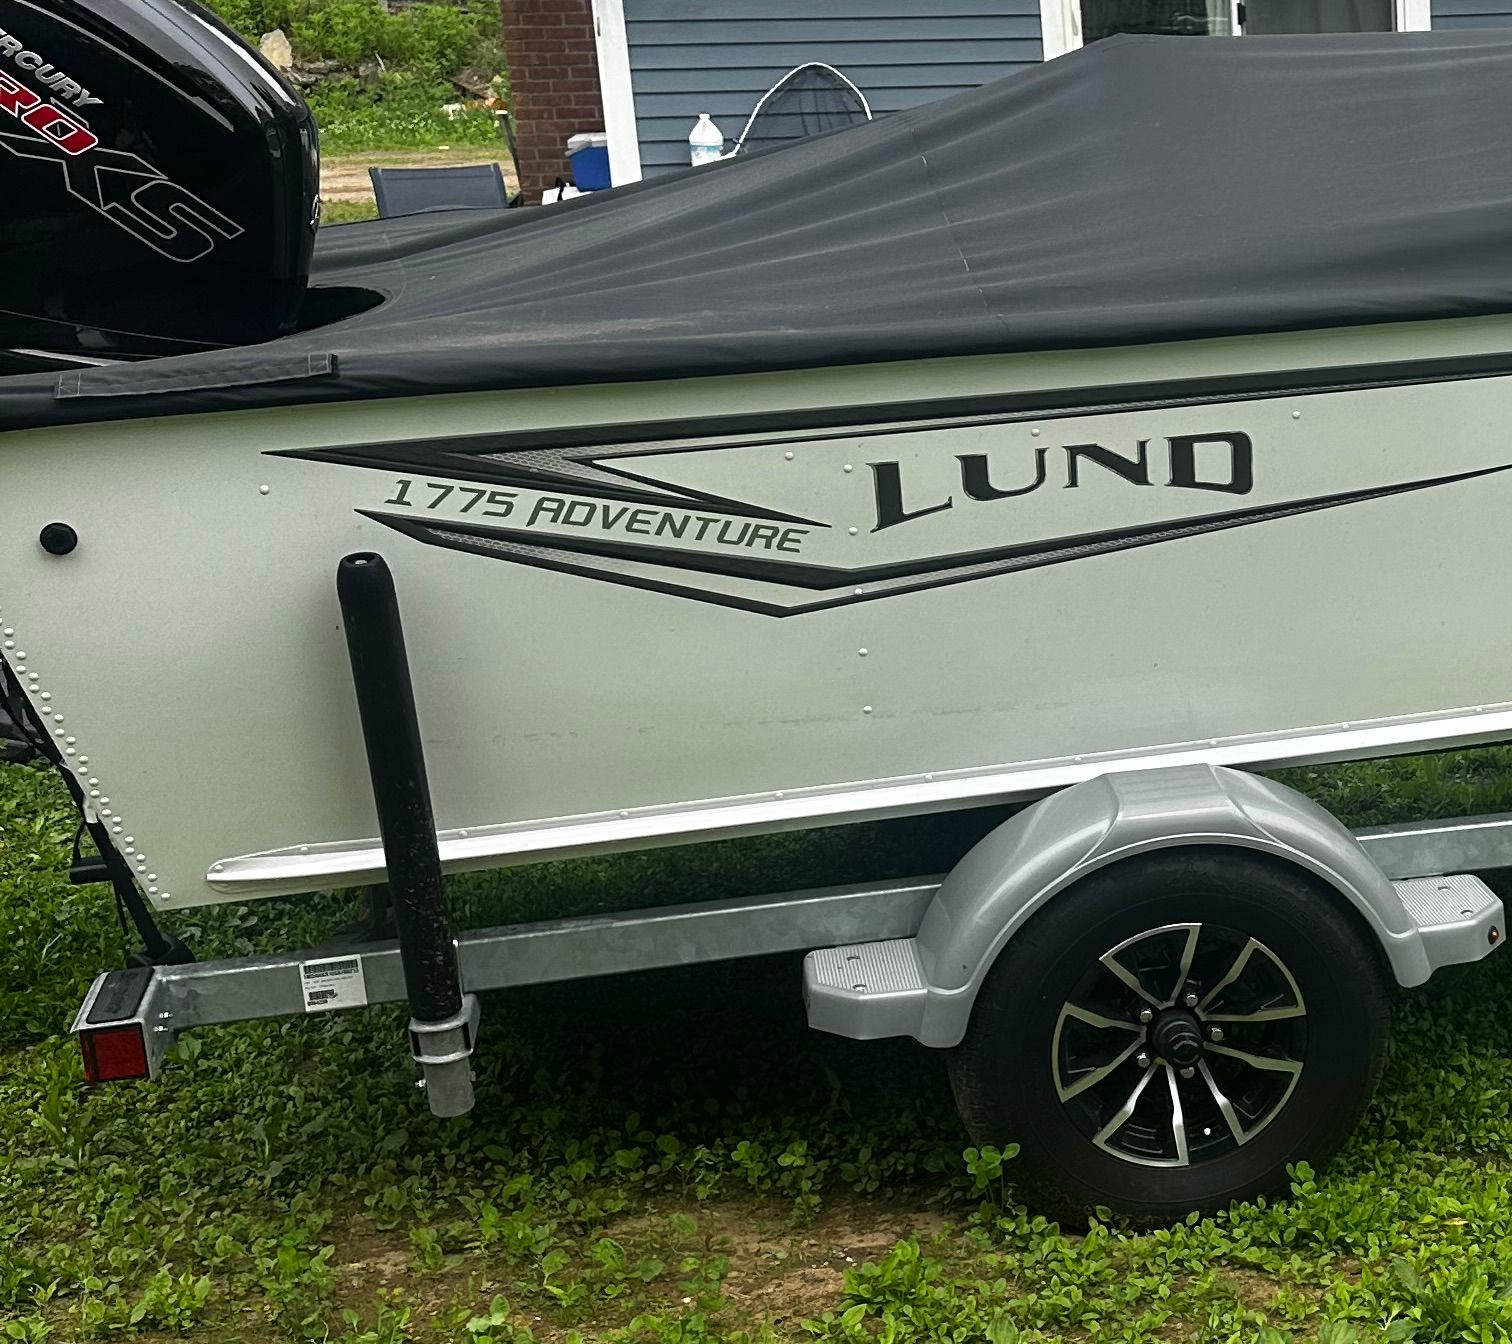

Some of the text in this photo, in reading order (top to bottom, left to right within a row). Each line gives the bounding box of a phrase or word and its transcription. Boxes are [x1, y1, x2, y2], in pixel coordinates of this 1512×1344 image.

[384, 478, 810, 554] 1775 ADVENTURE
[866, 430, 1253, 533] LUND
